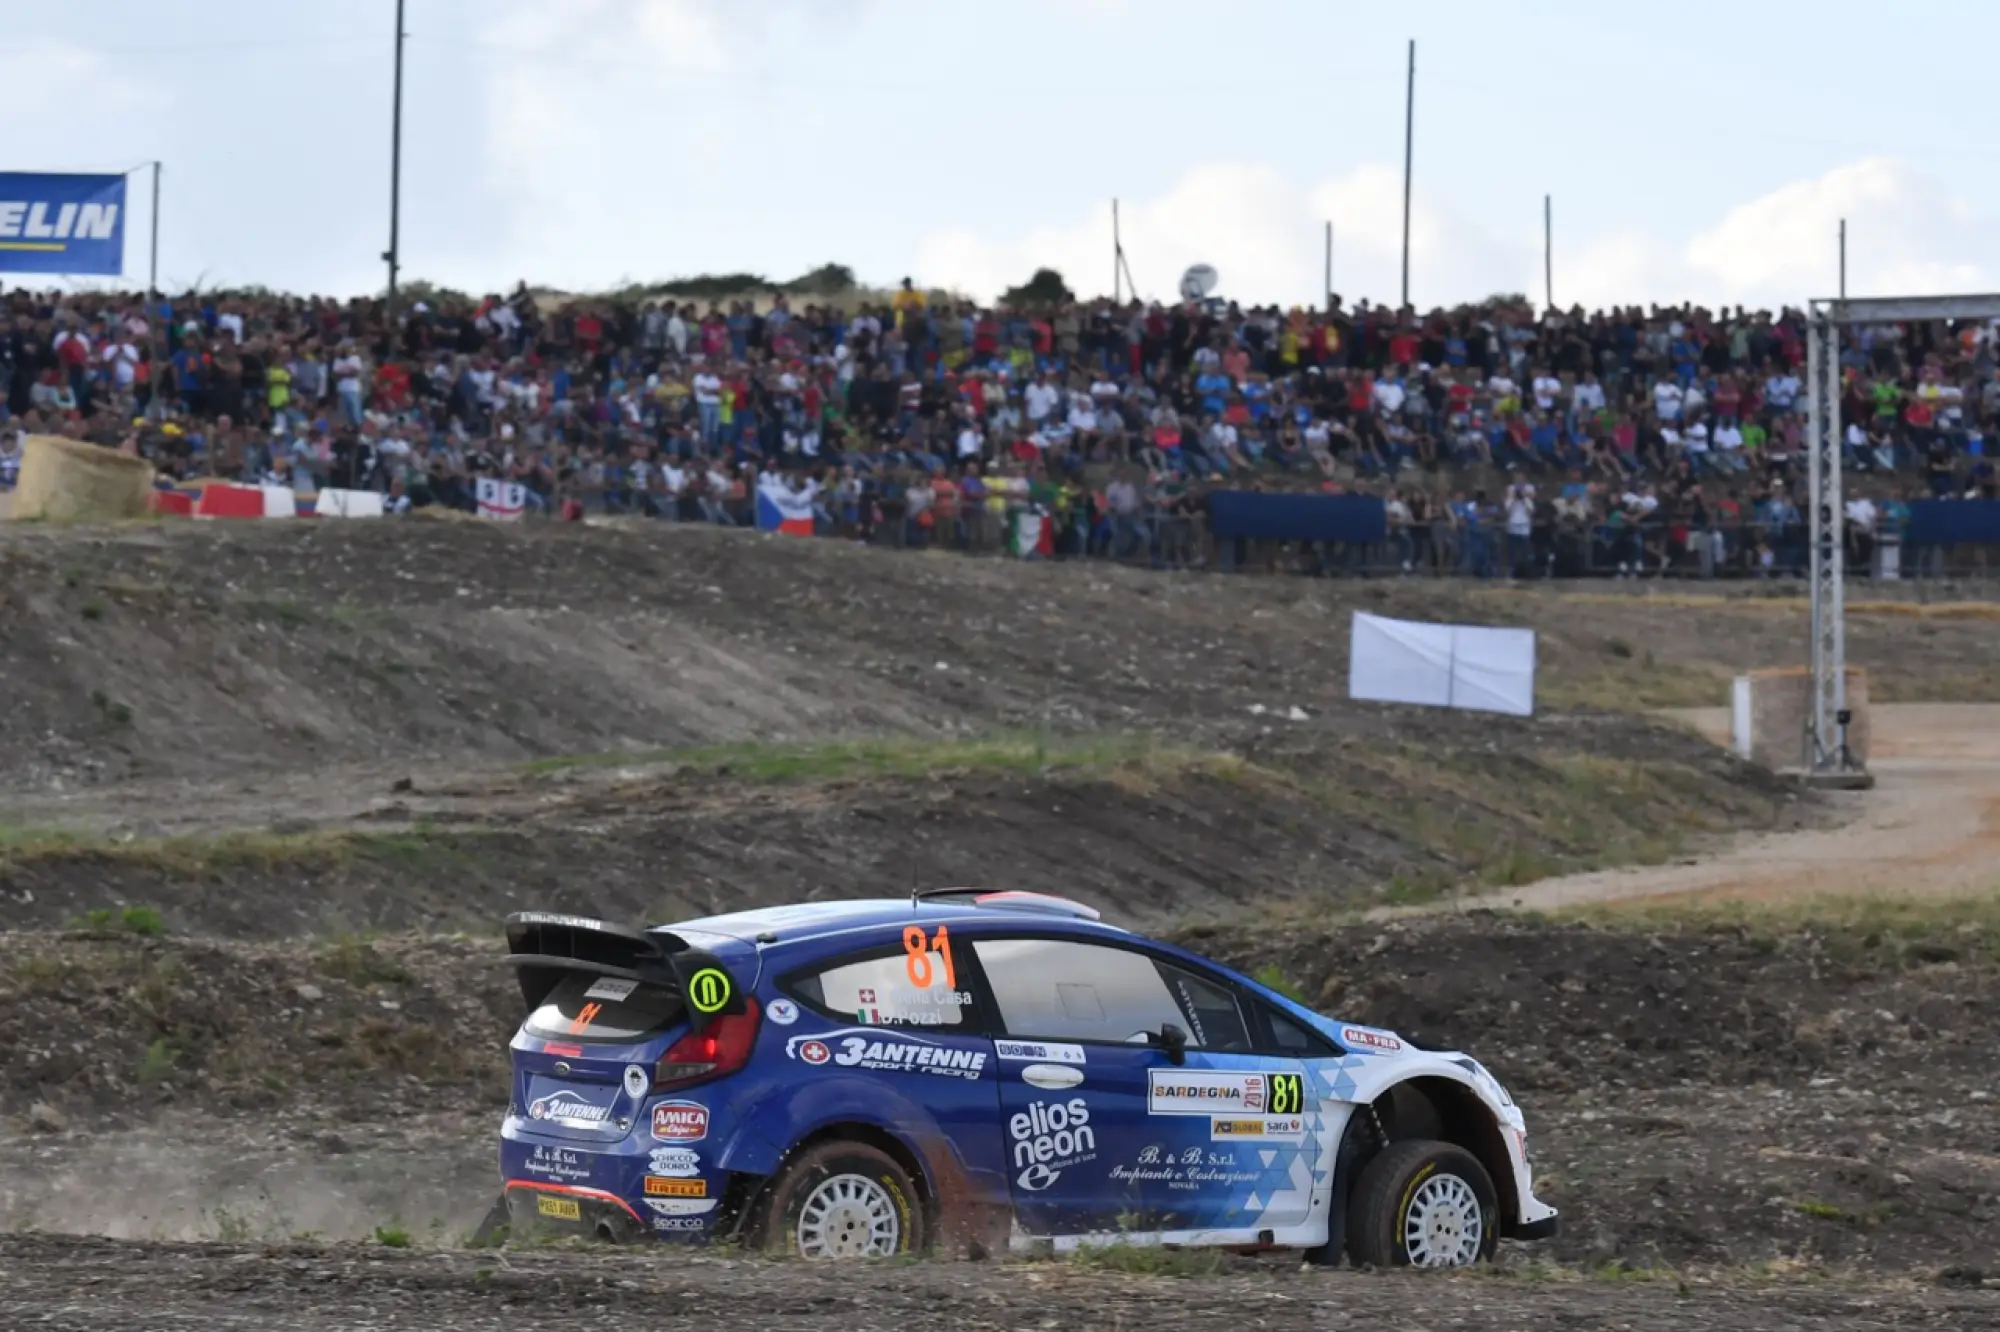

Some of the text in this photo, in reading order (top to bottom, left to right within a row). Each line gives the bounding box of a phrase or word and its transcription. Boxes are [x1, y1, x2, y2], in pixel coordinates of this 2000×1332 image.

[902, 924, 957, 989] 81
[934, 987, 973, 1005] Casa
[860, 1059, 981, 1080] sport racing
[1155, 1078, 1262, 1108] SARDEGNA 2016
[1273, 1075, 1299, 1113] 81
[655, 1109, 705, 1125] AMICA
[1010, 1097, 1090, 1140] elios
[1266, 1120, 1289, 1132] sara
[1232, 1123, 1263, 1133] GLOBAL
[1014, 1125, 1096, 1169] neon
[1165, 1153, 1176, 1165] &
[1108, 1164, 1174, 1185] Impianti
[1187, 1166, 1261, 1186] Costruzioni
